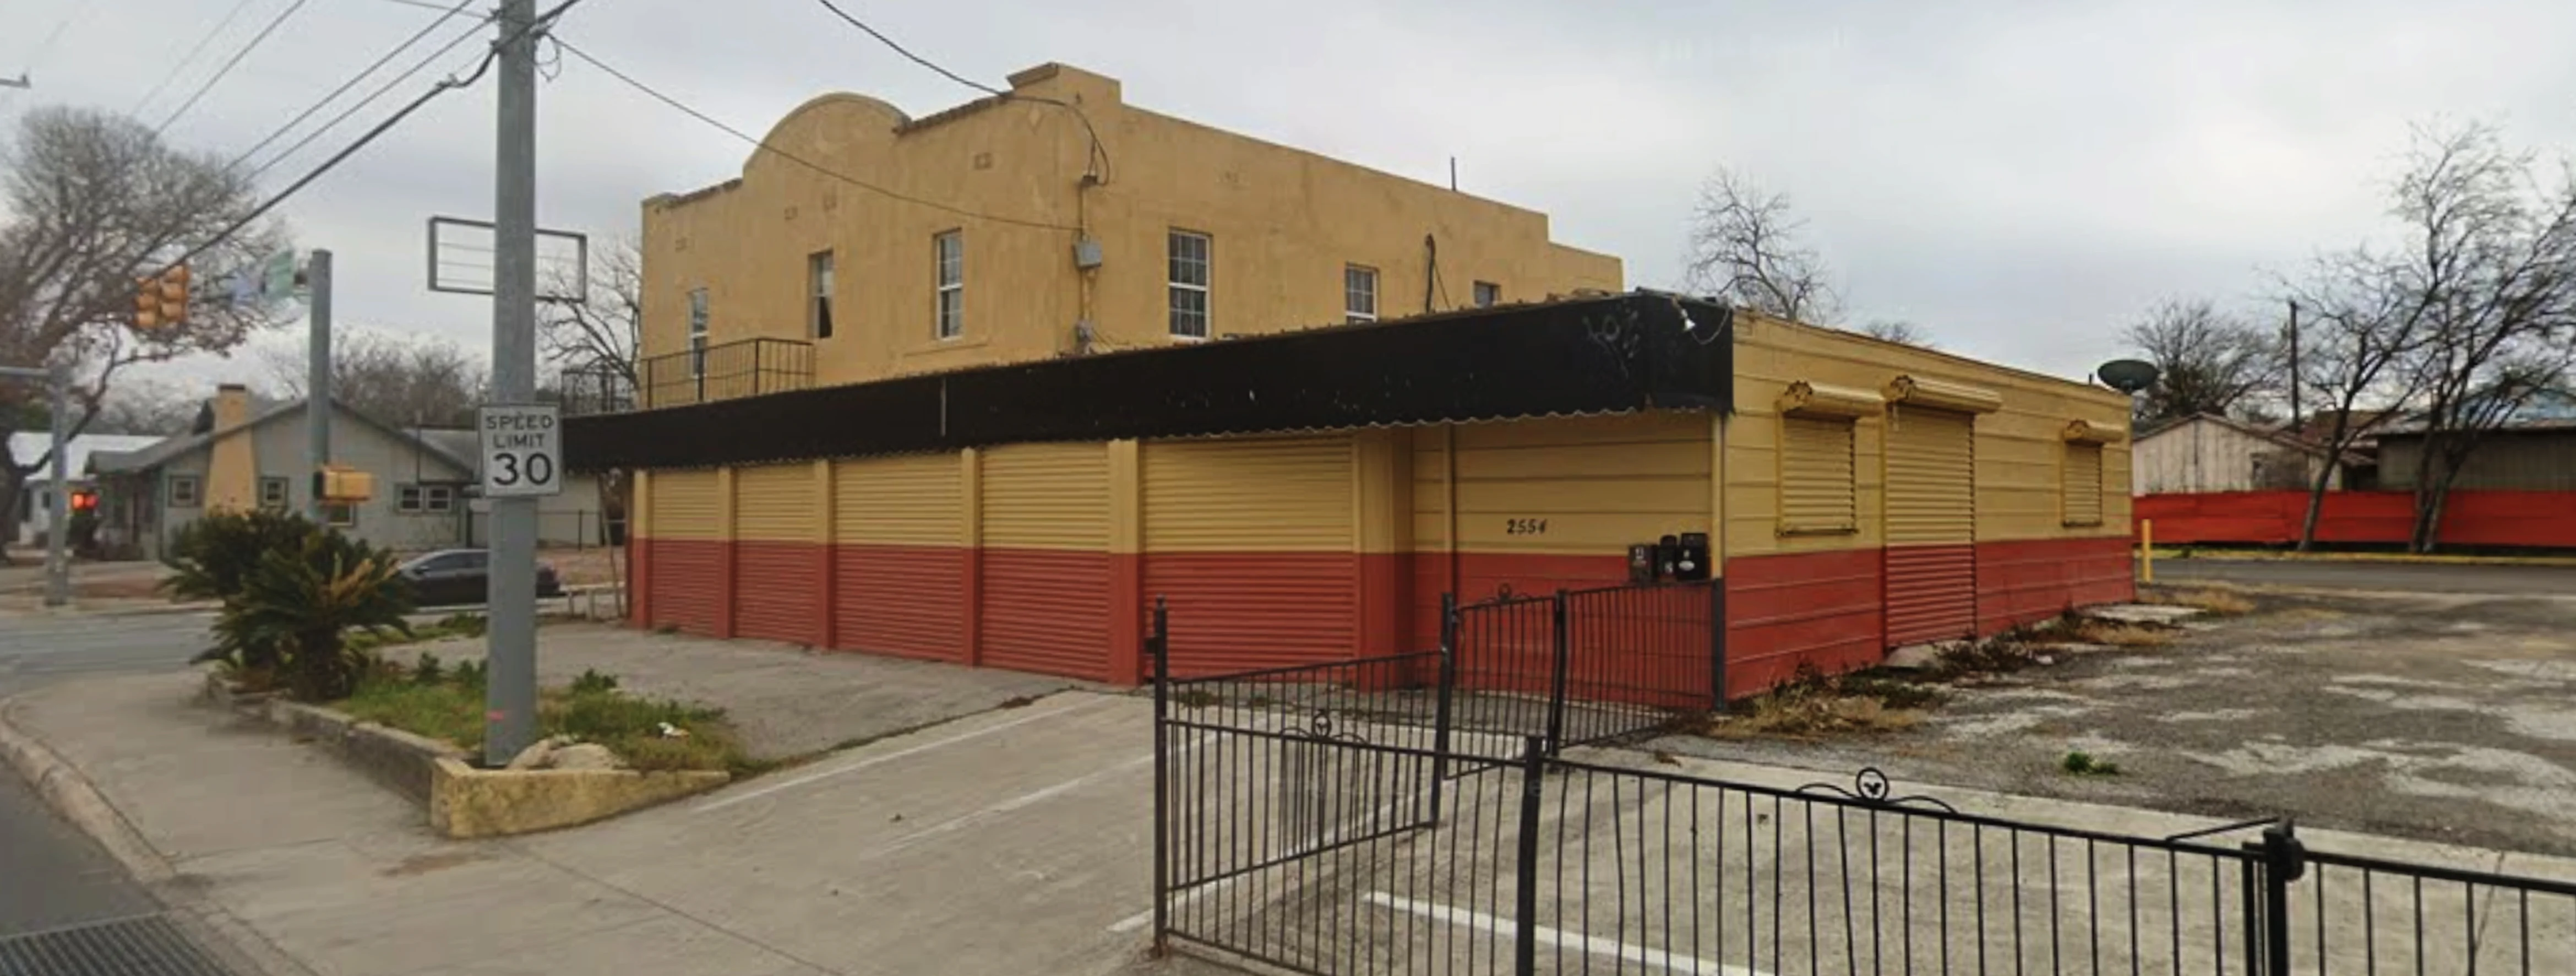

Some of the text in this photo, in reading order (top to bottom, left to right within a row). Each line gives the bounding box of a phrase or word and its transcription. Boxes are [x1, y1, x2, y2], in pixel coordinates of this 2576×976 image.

[486, 414, 553, 430] SPEED
[493, 433, 545, 448] LIMIT
[493, 452, 552, 485] 30
[1506, 518, 1548, 535] 2554
